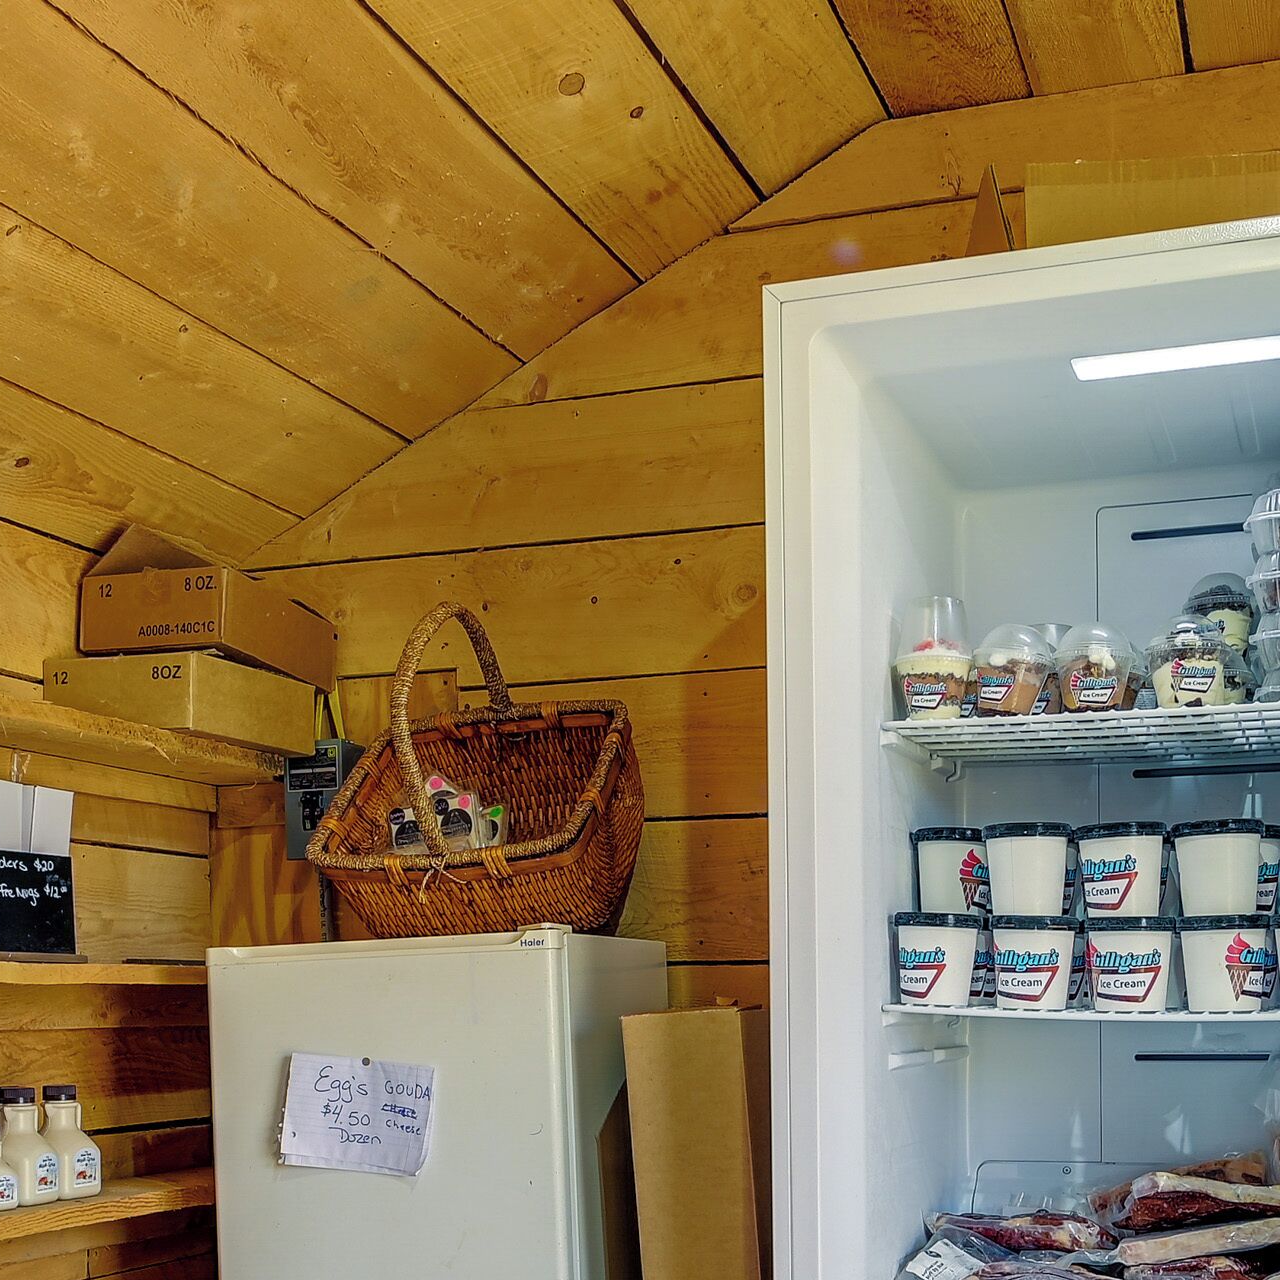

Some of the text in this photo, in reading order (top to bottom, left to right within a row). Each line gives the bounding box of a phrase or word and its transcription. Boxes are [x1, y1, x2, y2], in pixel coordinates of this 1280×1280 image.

[98, 576, 217, 598] 12 8 OZ.
[138, 621, 215, 638] A0008-140C1C
[52, 665, 182, 686] 12 8OZ
[34, 858, 54, 873] $20
[1091, 886, 1120, 897] Cream
[520, 938, 544, 947] Haier
[1000, 977, 1043, 988] Ice Cream
[1100, 978, 1146, 989] Ice Cream
[314, 1065, 431, 1104] Egg's GOUDA
[320, 1102, 371, 1127] $4.50
[328, 1126, 382, 1145] Dozen
